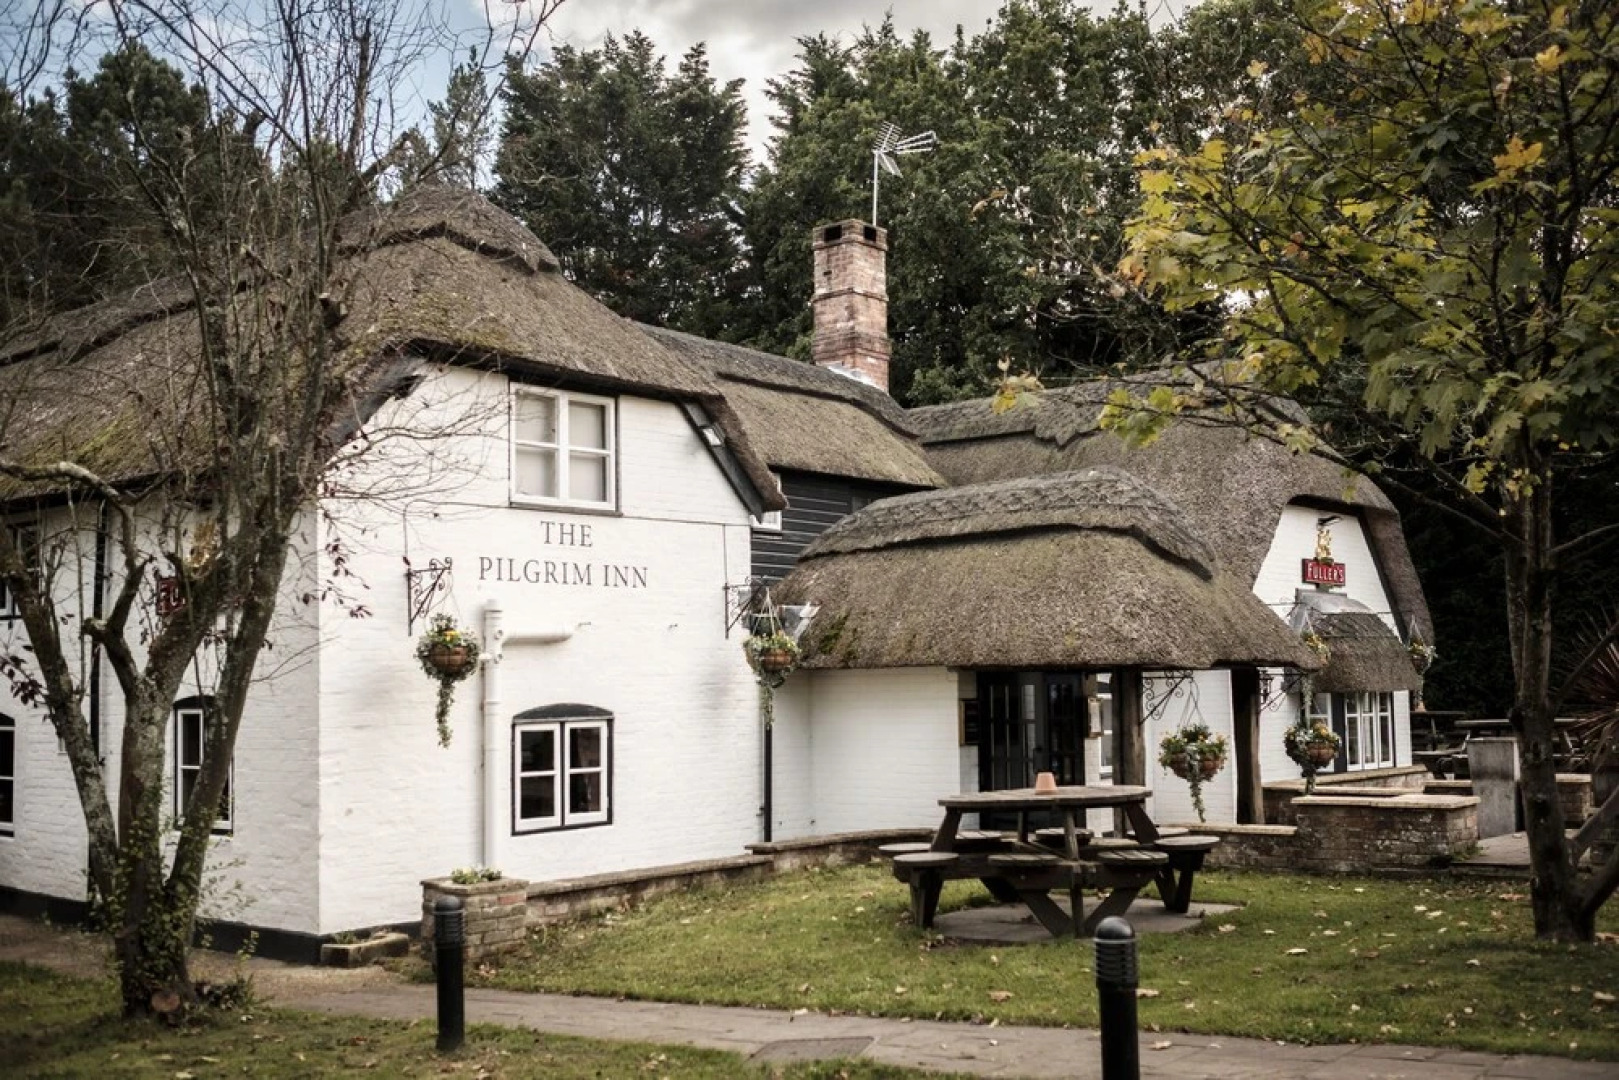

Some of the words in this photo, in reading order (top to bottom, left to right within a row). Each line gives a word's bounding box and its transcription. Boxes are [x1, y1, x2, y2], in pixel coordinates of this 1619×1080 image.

[540, 520, 593, 547] THE
[478, 556, 592, 586] PILGRIM
[603, 564, 649, 589] INN
[1307, 563, 1344, 582] FULLER'S
